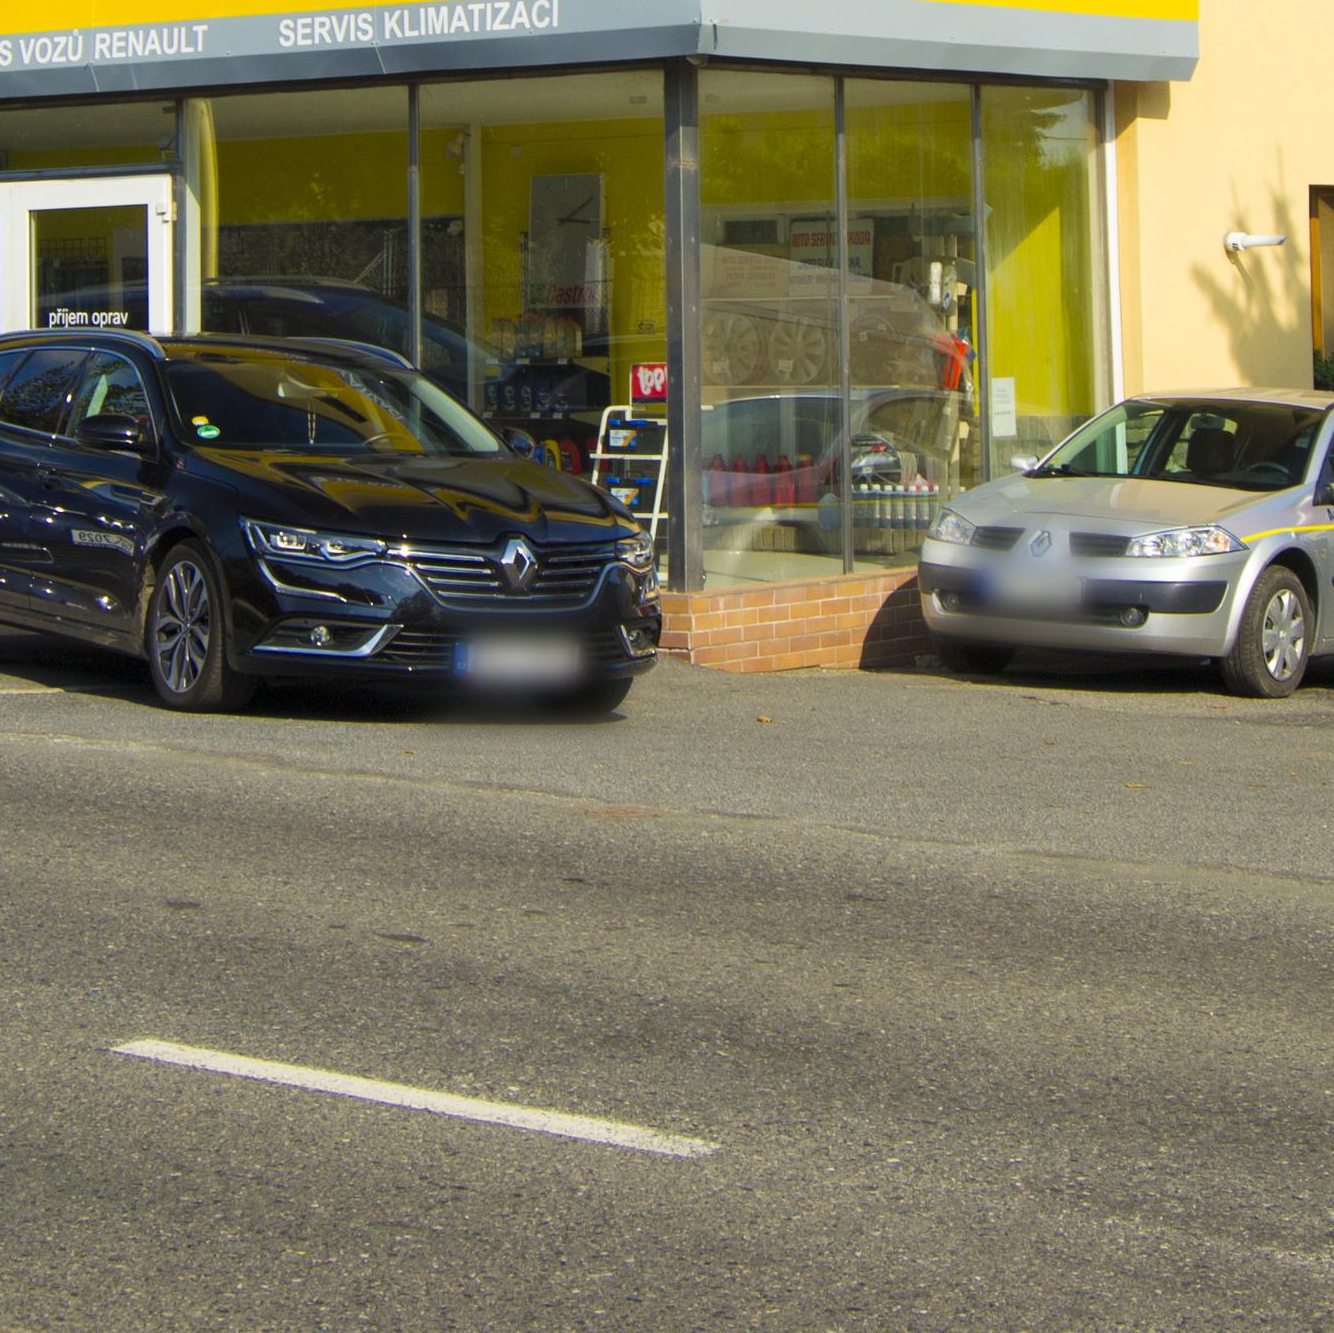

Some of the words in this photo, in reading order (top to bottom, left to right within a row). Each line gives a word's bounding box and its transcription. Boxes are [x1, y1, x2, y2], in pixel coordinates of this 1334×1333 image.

[19, 29, 83, 65] VOZŮ
[94, 25, 208, 60] RENAULT
[278, 13, 374, 47] SERVIS
[49, 308, 88, 329] příjem
[91, 311, 129, 328] oprav
[637, 366, 667, 395] top
